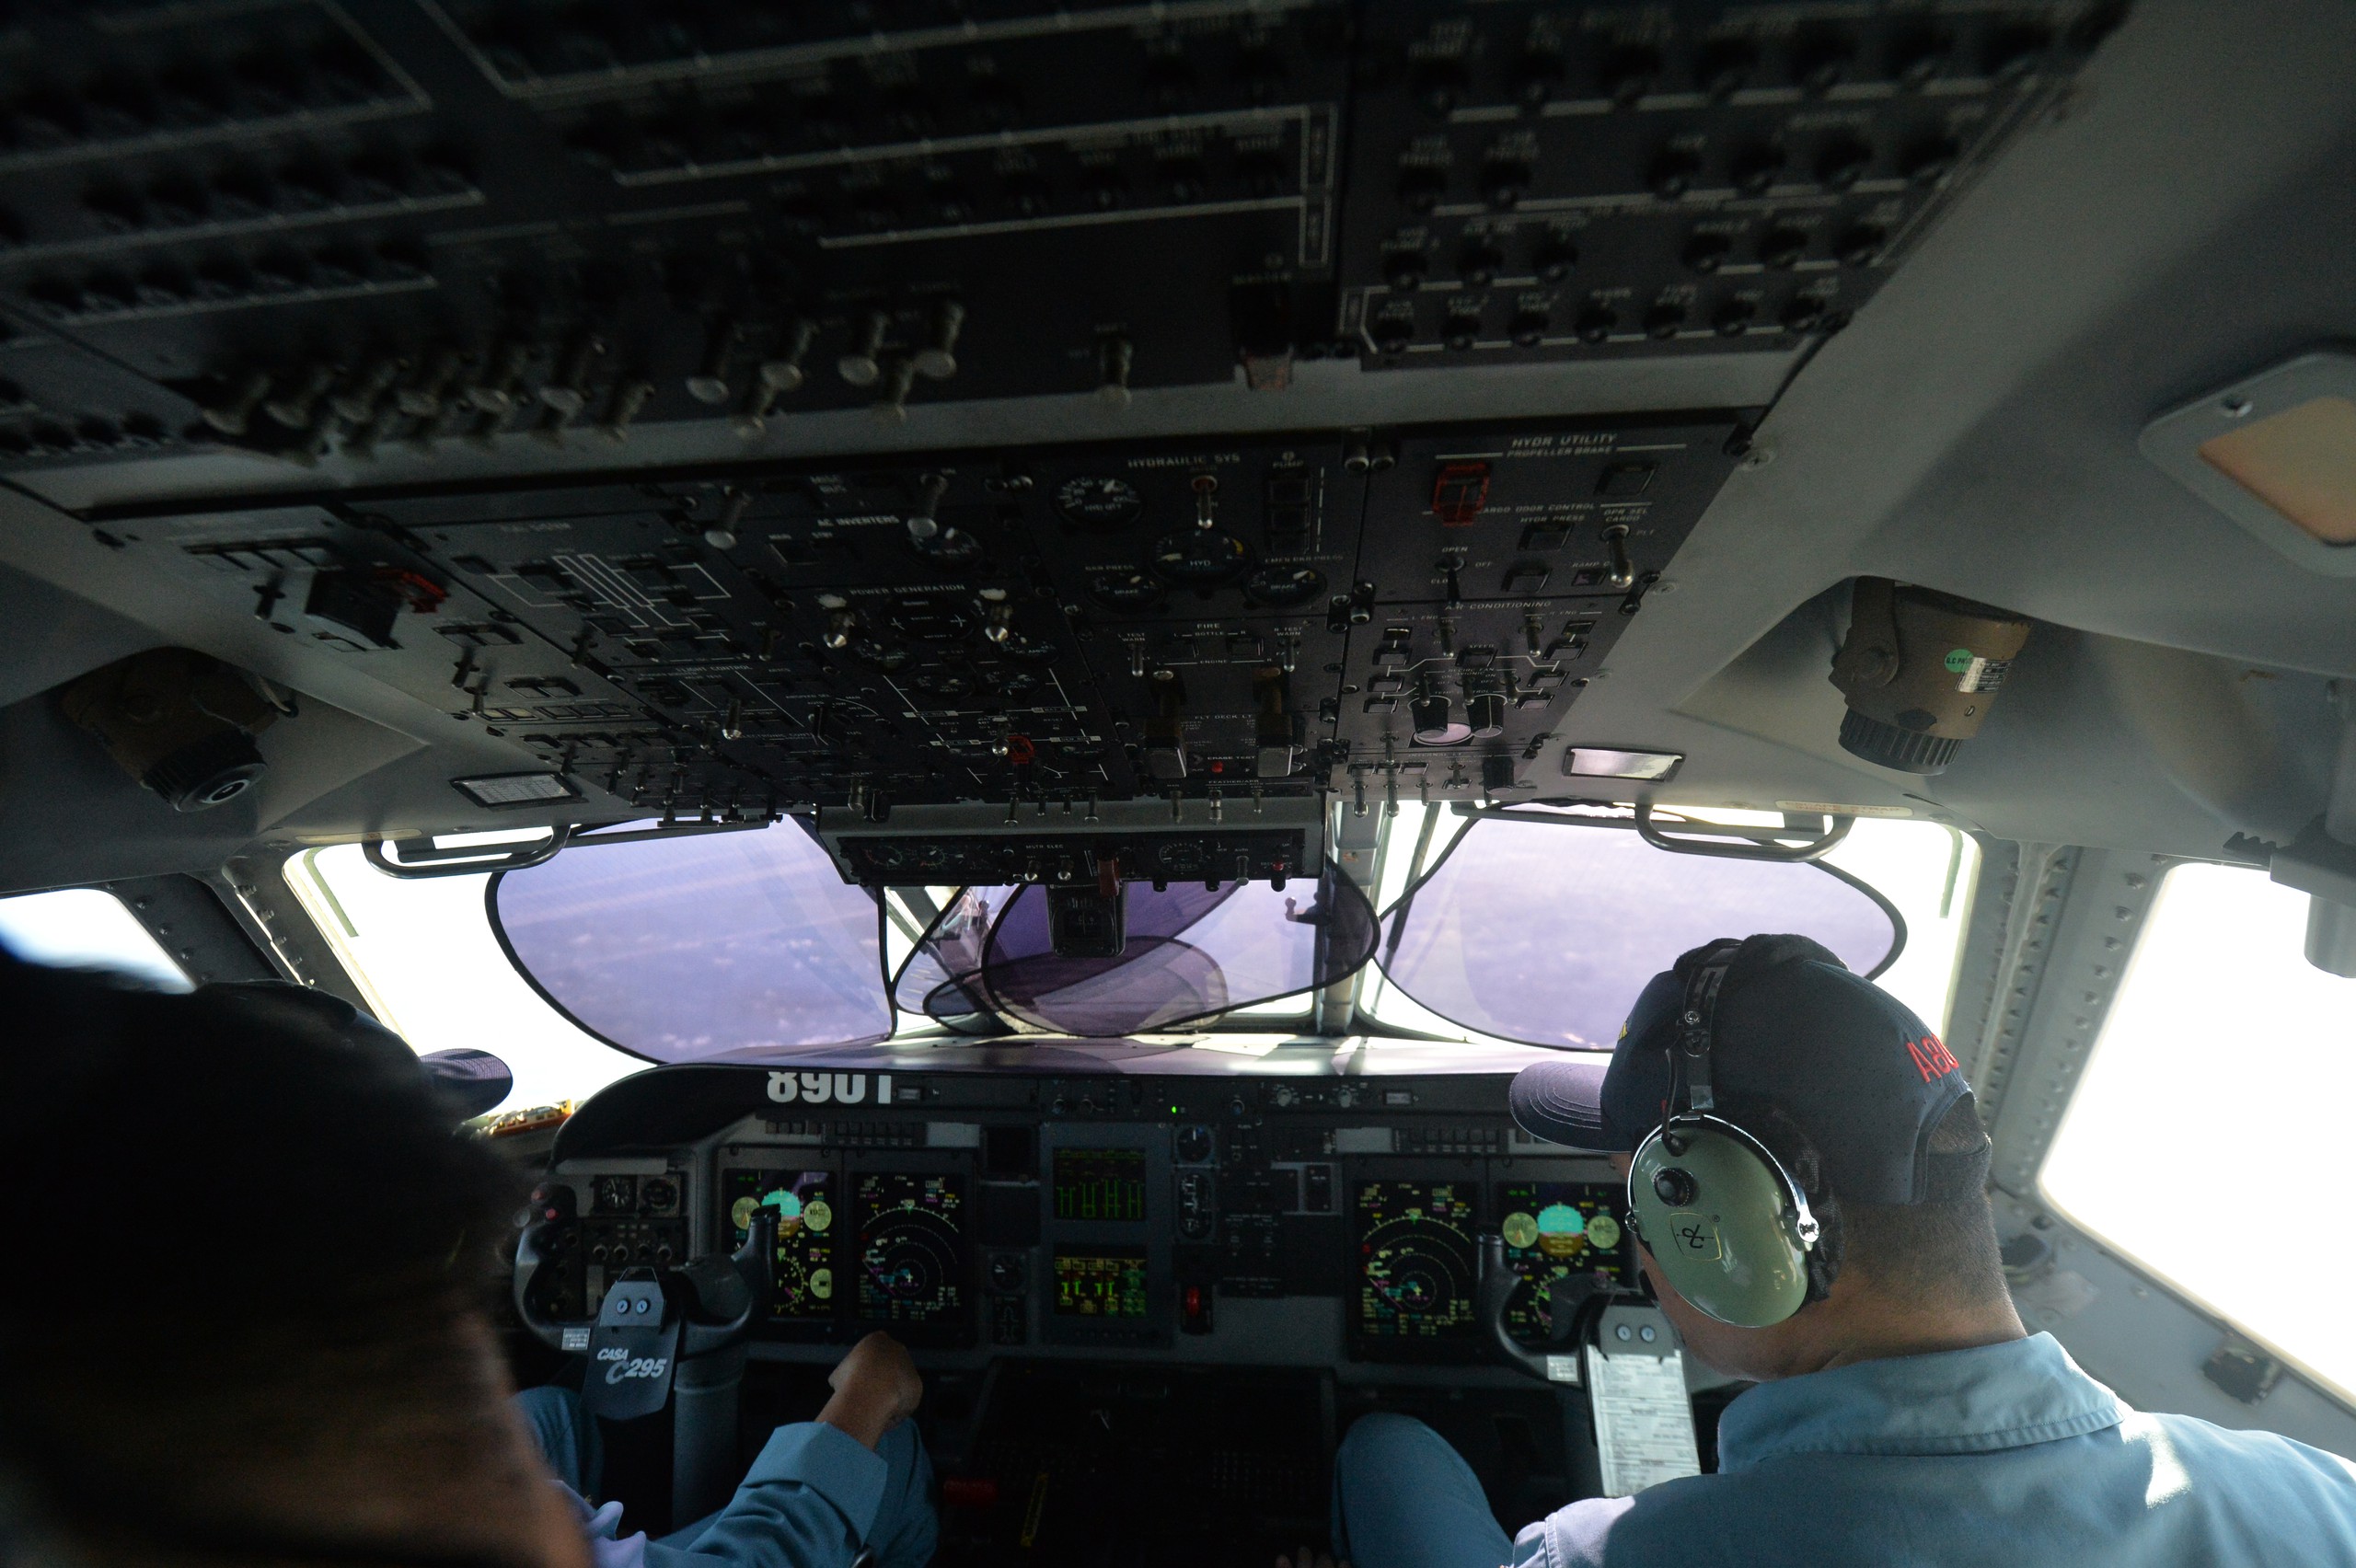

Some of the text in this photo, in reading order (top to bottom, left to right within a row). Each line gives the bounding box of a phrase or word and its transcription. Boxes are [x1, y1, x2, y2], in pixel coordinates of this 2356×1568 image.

[1511, 433, 1618, 448] HYDR UTILITY
[1507, 445, 1612, 458] PROPELLER BRAKE
[1127, 453, 1242, 468] HYDRAULIC SYS
[1273, 460, 1305, 469] PUMP
[1516, 504, 1543, 513] ODOR
[1549, 502, 1595, 512] CONTROL
[849, 584, 966, 596] POWER GENERATION
[1470, 601, 1552, 610] CONDITIONING
[596, 1347, 629, 1361] CASA
[605, 1357, 668, 1385] C295
